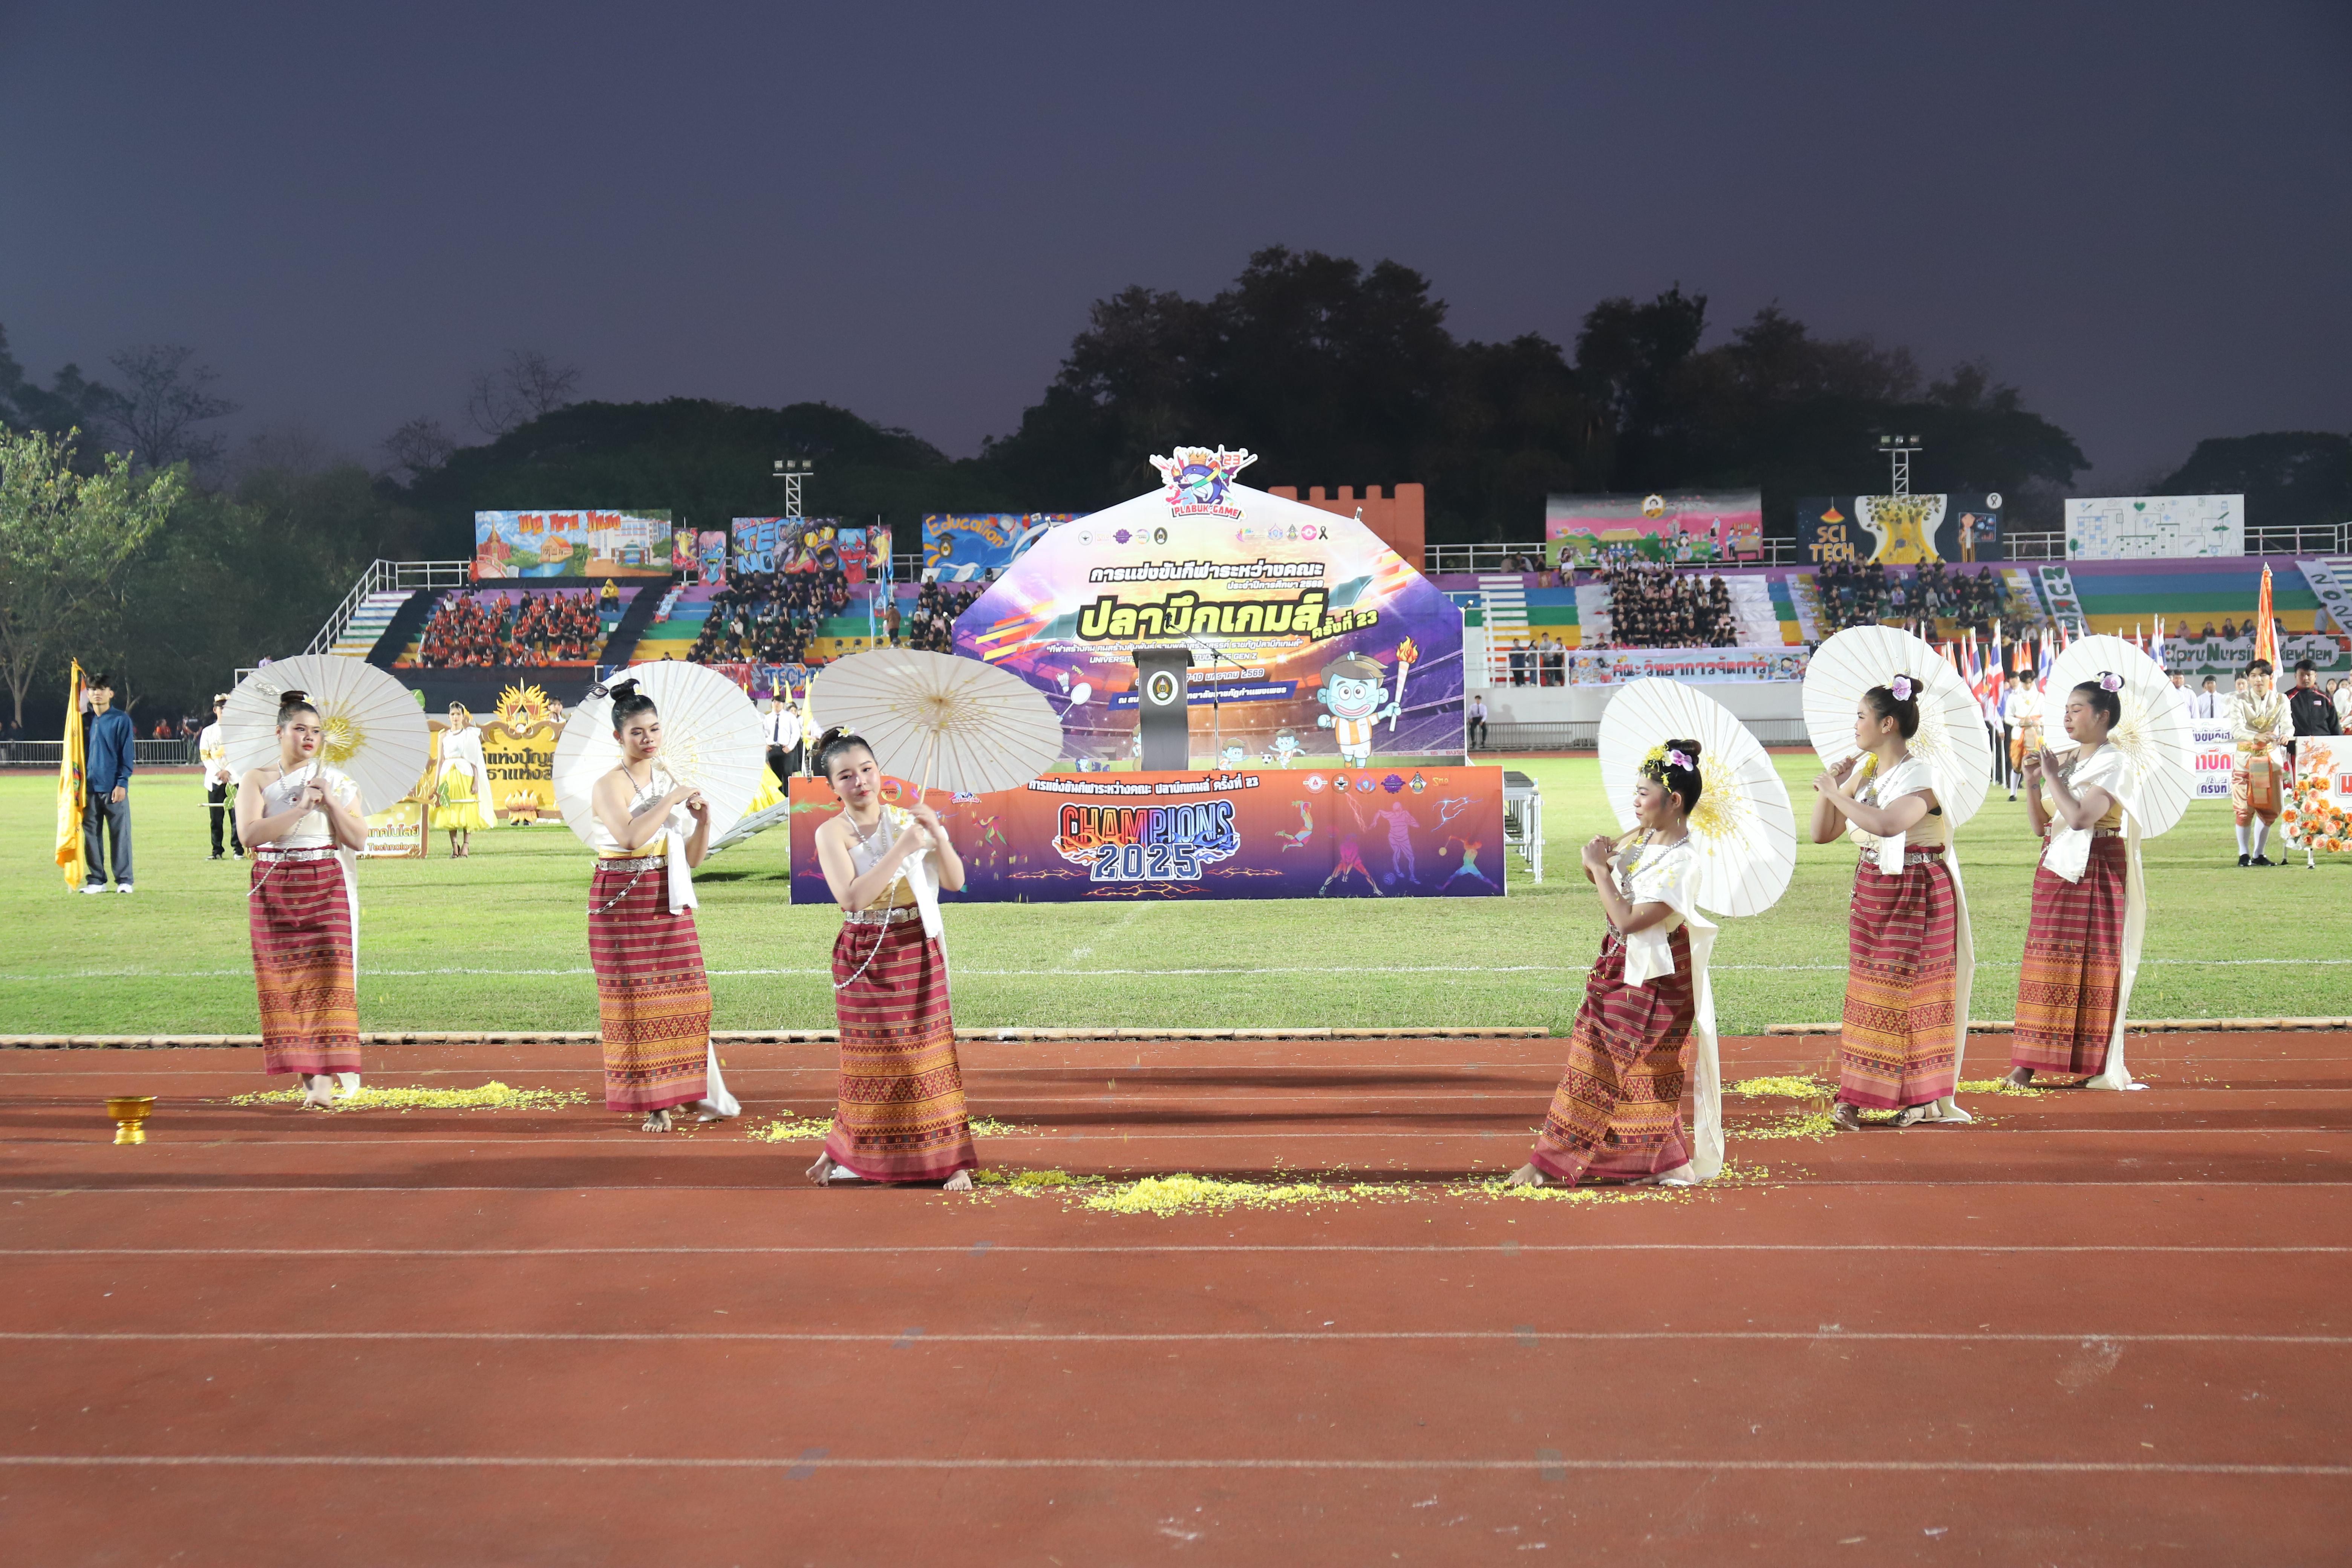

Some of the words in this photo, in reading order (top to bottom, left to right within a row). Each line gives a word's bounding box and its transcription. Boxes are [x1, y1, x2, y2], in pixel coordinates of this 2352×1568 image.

[1223, 454, 1240, 465] 23
[1174, 504, 1208, 515] PLABUK
[1213, 505, 1239, 517] GAME
[926, 514, 1005, 547] Education
[1817, 525, 1846, 543] SCI
[738, 550, 775, 574] NO
[1809, 542, 1855, 562] TECH
[1091, 559, 1324, 581] การแข่งขันกีฬาระหว่างคณะ
[1227, 580, 1298, 590] ประจำปีการศึกษา
[1080, 592, 1324, 636] ปลาบึกเกมส์
[1312, 609, 1353, 640] ครั้งที่
[1356, 609, 1378, 627] 23
[1072, 665, 1085, 677] POW!
[1240, 669, 1265, 678] 2569
[1613, 663, 1642, 677] คณะ
[1028, 779, 1152, 795] การแข่งขันกีฬาระหว่างคณะ
[1213, 772, 1243, 791] ครั้งที่
[1245, 776, 1259, 788] 23
[368, 824, 419, 838] เทคโนโลยี
[1061, 802, 1233, 847] CHAMPIONS
[1092, 842, 1200, 880] 2025
